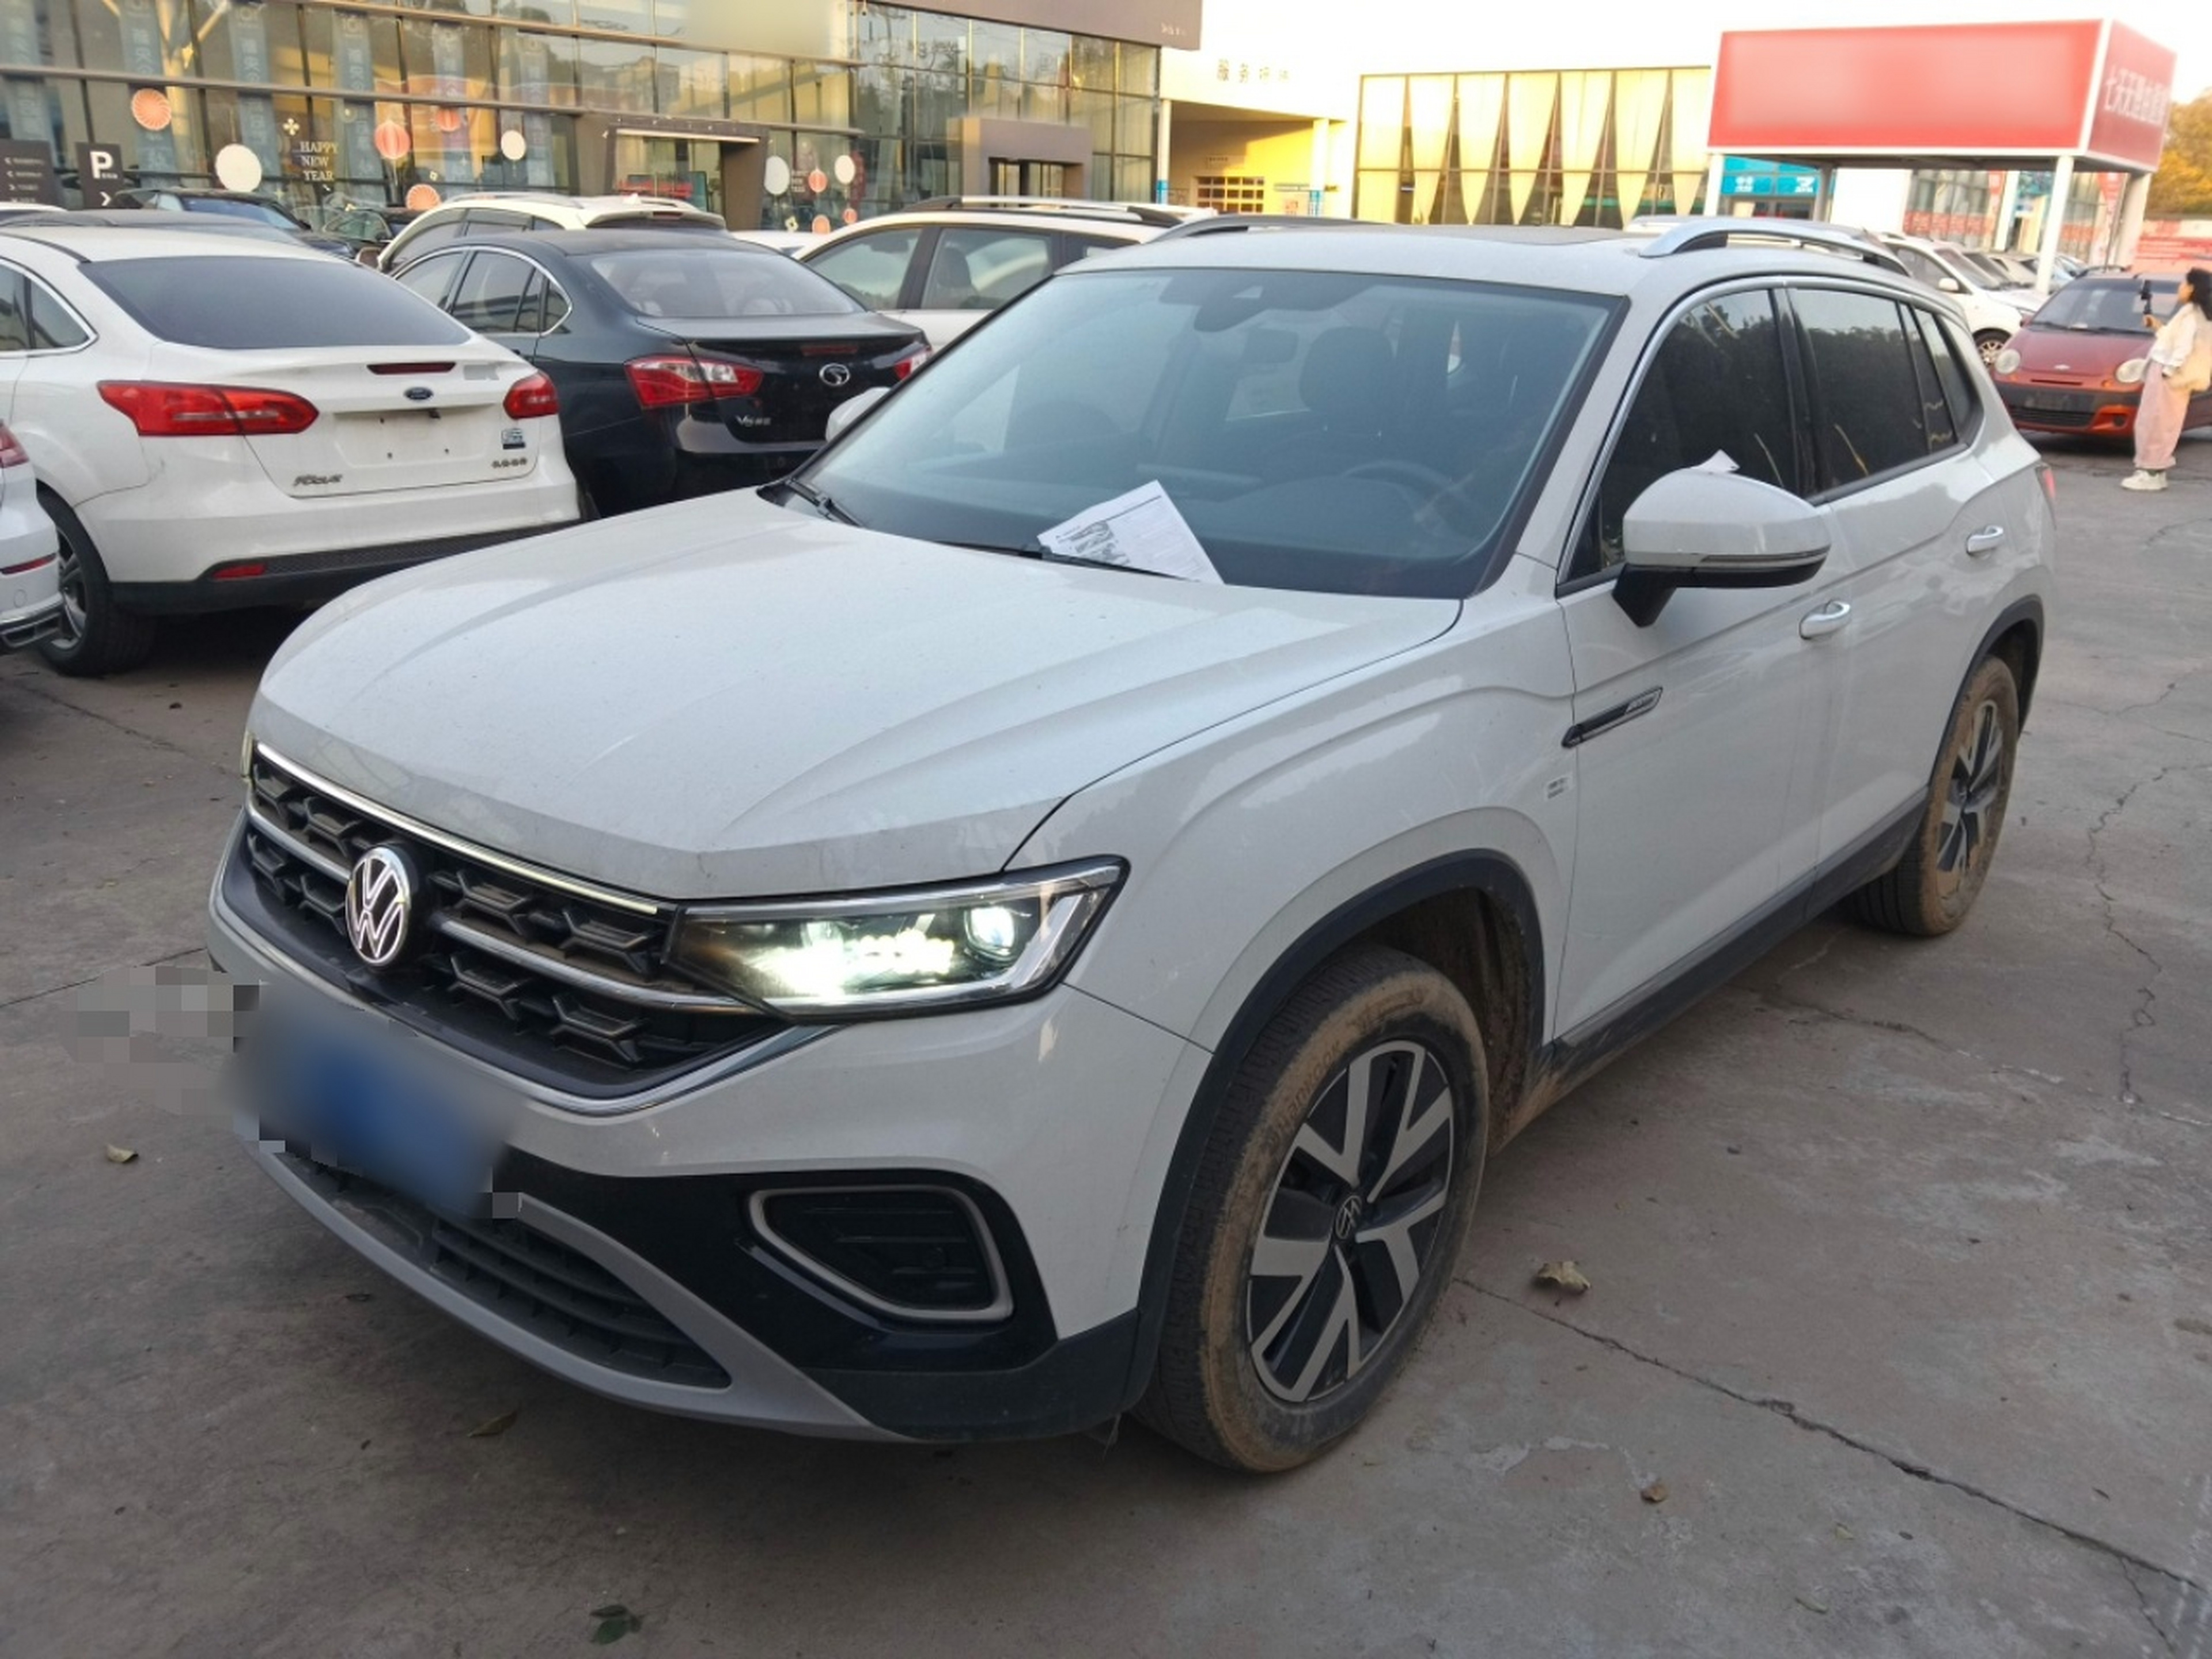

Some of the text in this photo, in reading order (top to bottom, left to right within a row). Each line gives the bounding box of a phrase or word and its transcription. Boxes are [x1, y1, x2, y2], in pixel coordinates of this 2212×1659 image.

[300, 141, 338, 154] HAPPY
[90, 151, 113, 179] P
[301, 156, 329, 167] NEW
[302, 170, 335, 181] YEAR
